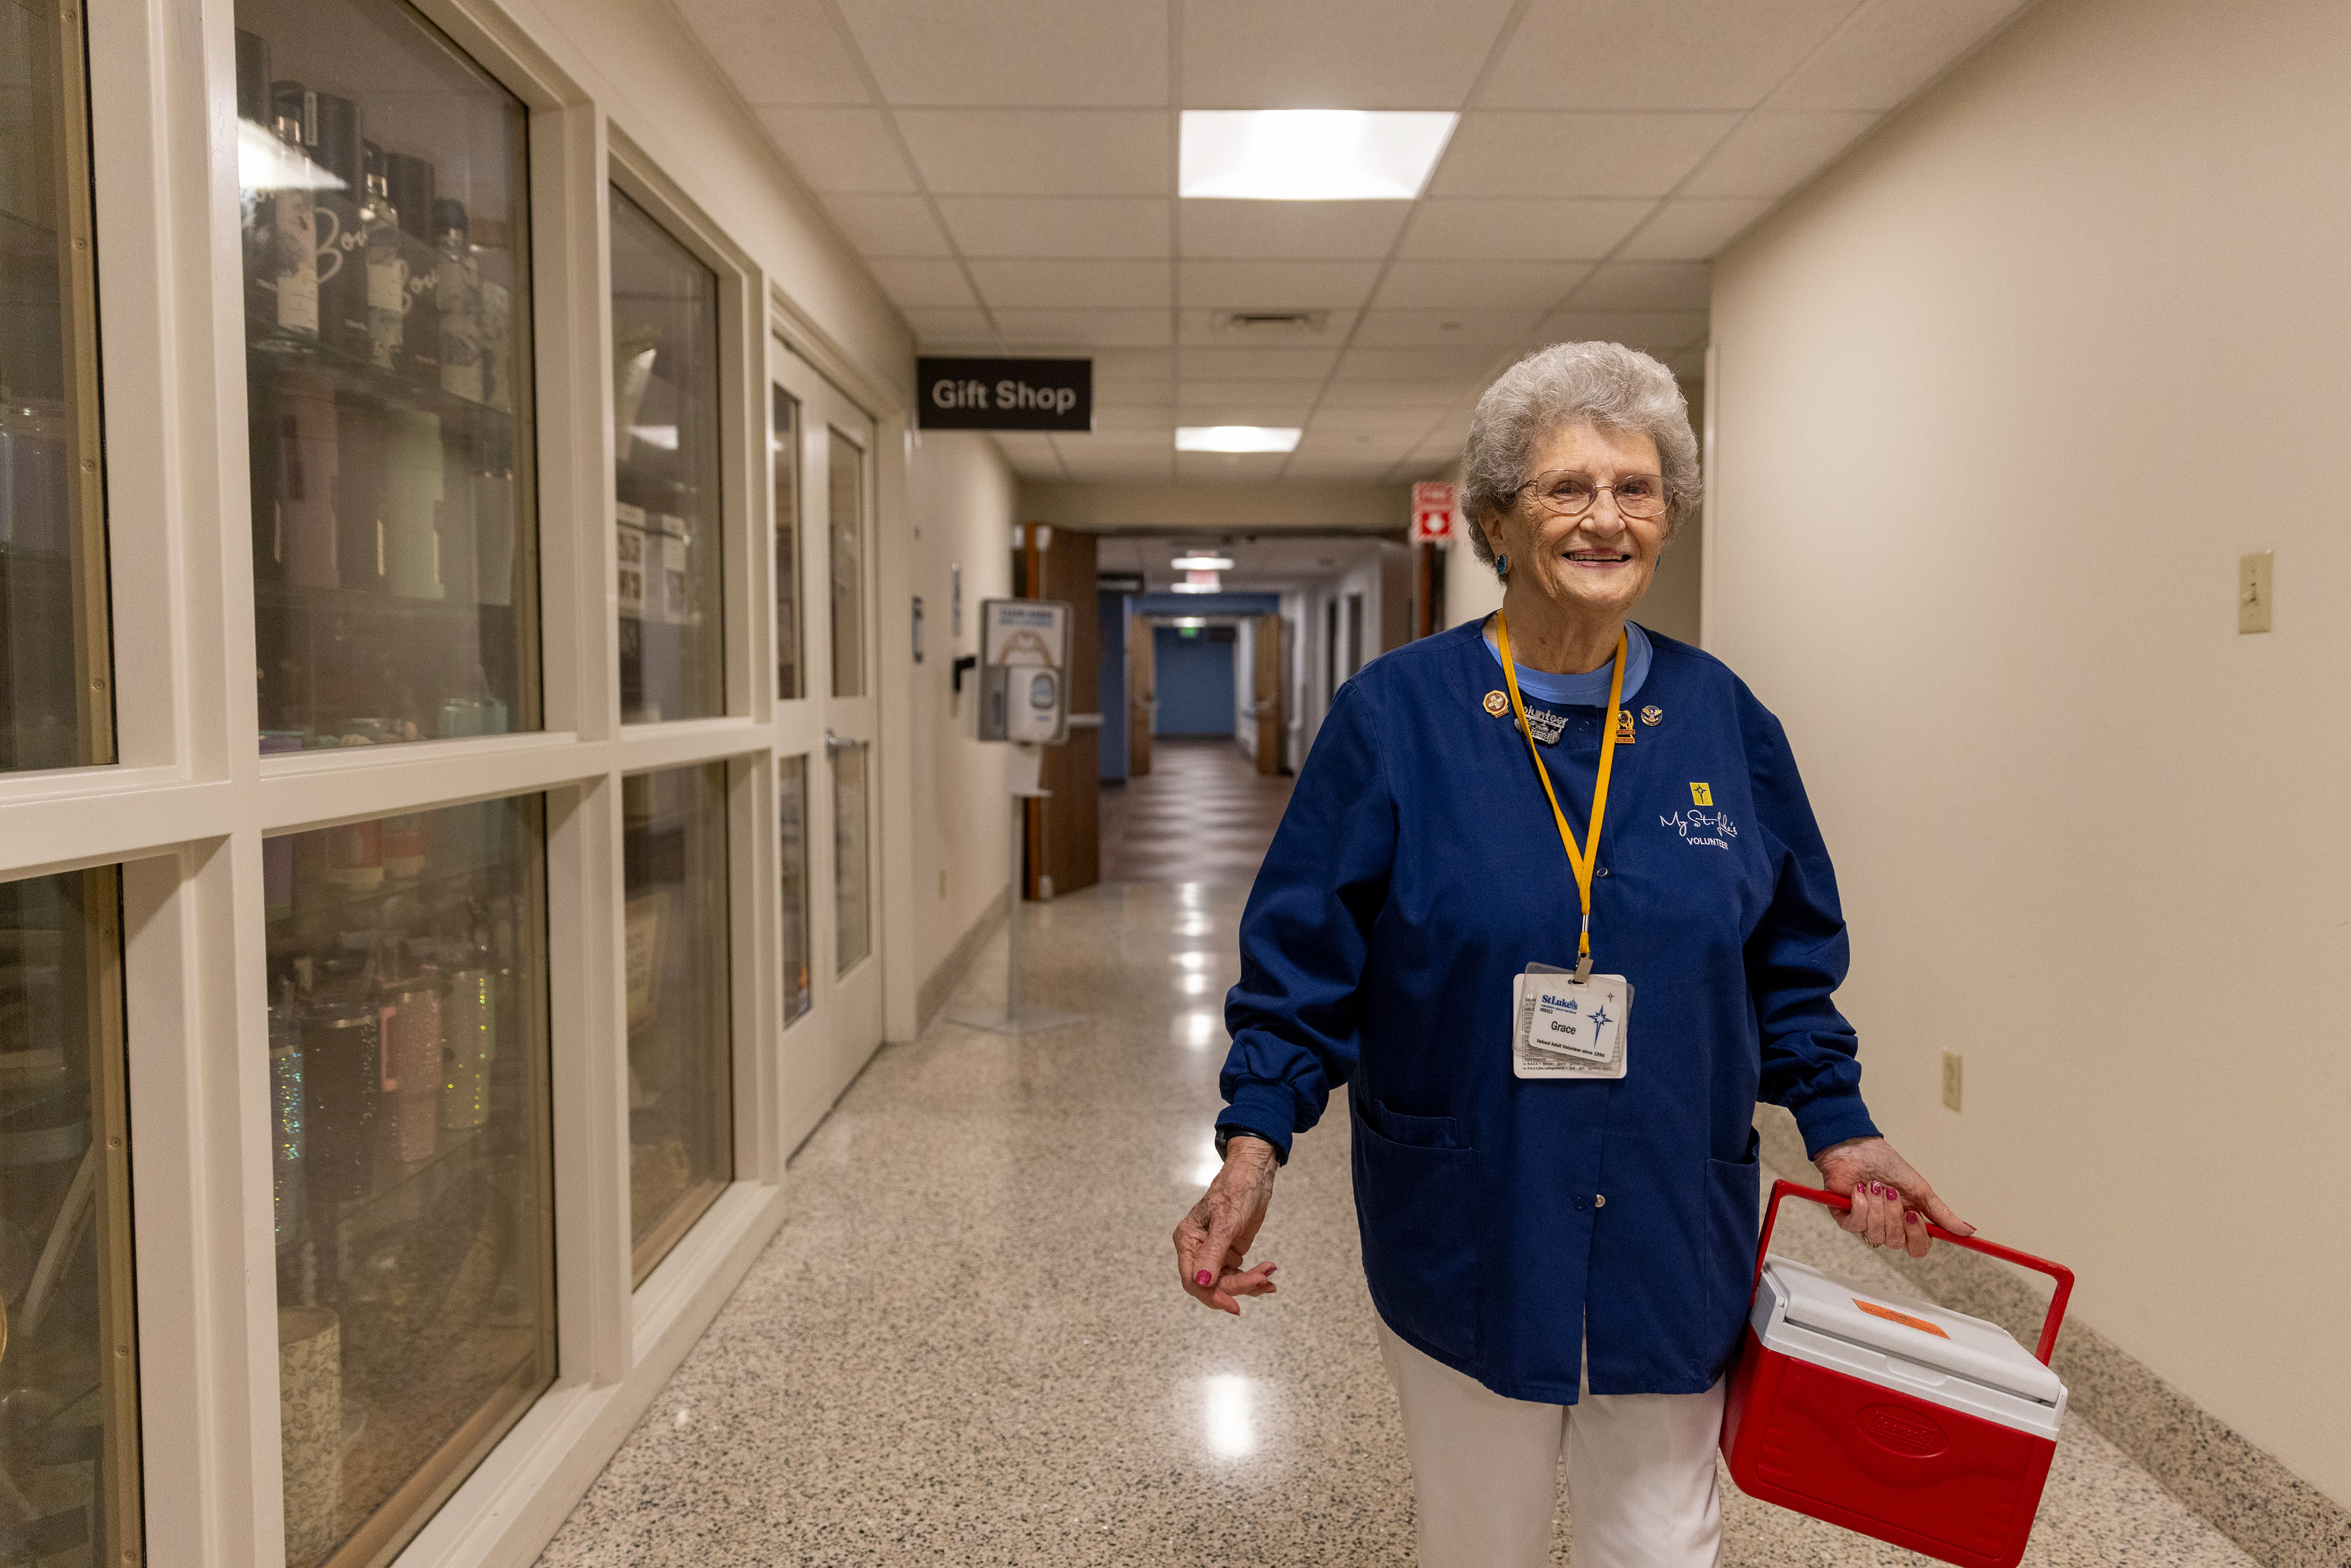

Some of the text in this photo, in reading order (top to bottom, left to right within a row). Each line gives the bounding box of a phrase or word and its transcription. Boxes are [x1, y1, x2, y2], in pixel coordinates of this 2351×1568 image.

[932, 379, 1077, 416] Gift Shop
[1524, 705, 1569, 726] olunteer
[1660, 811, 1687, 836] My
[1686, 837, 1728, 850] VOLUNTEER
[1551, 1021, 1576, 1035] Grace
